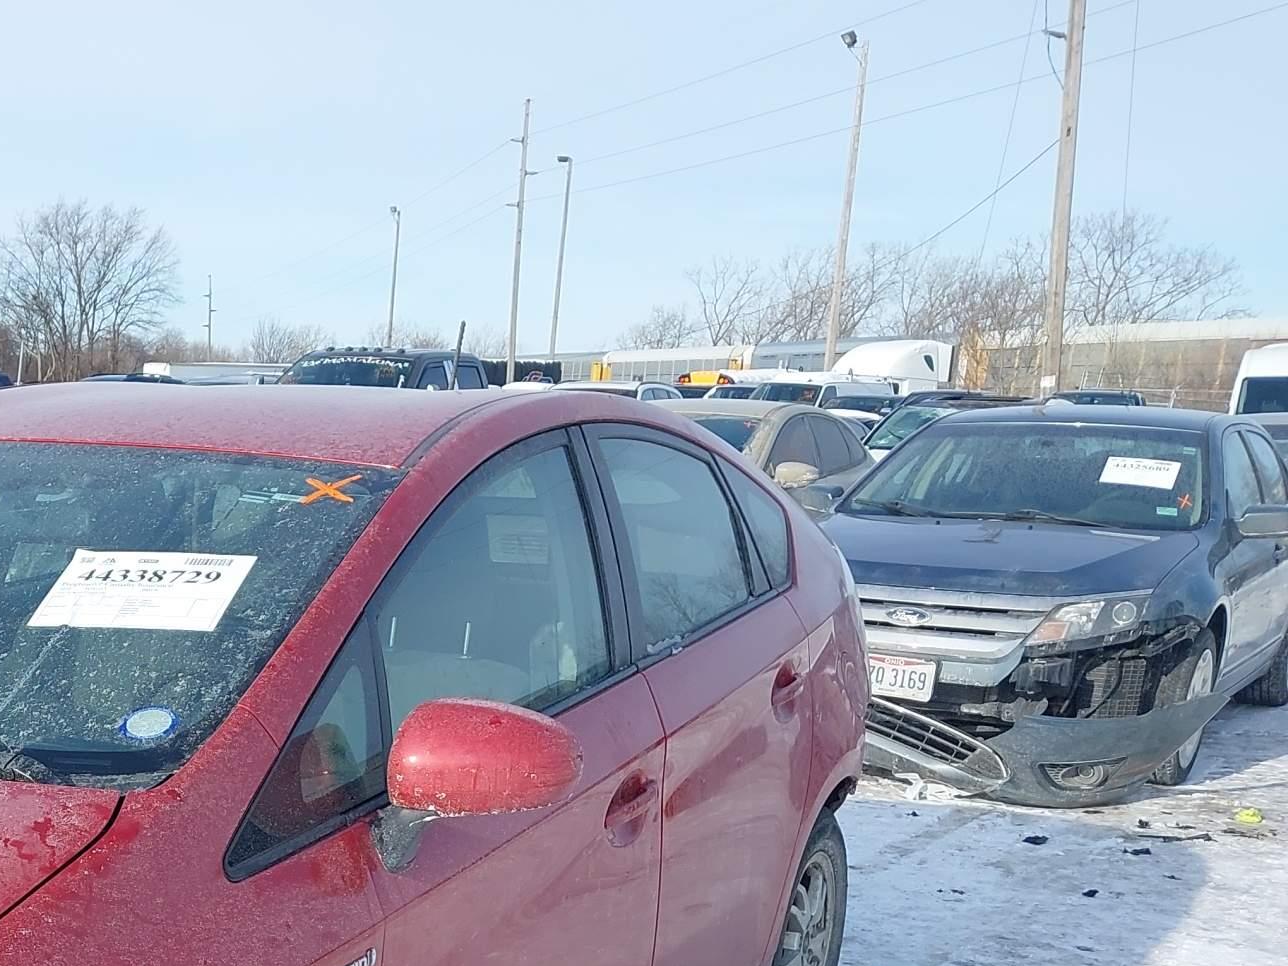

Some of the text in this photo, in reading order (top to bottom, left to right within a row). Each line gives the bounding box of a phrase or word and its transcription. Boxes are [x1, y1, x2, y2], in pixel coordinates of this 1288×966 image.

[77, 568, 222, 585] 44338729
[892, 607, 920, 624] Ford
[888, 668, 927, 691] 3169
